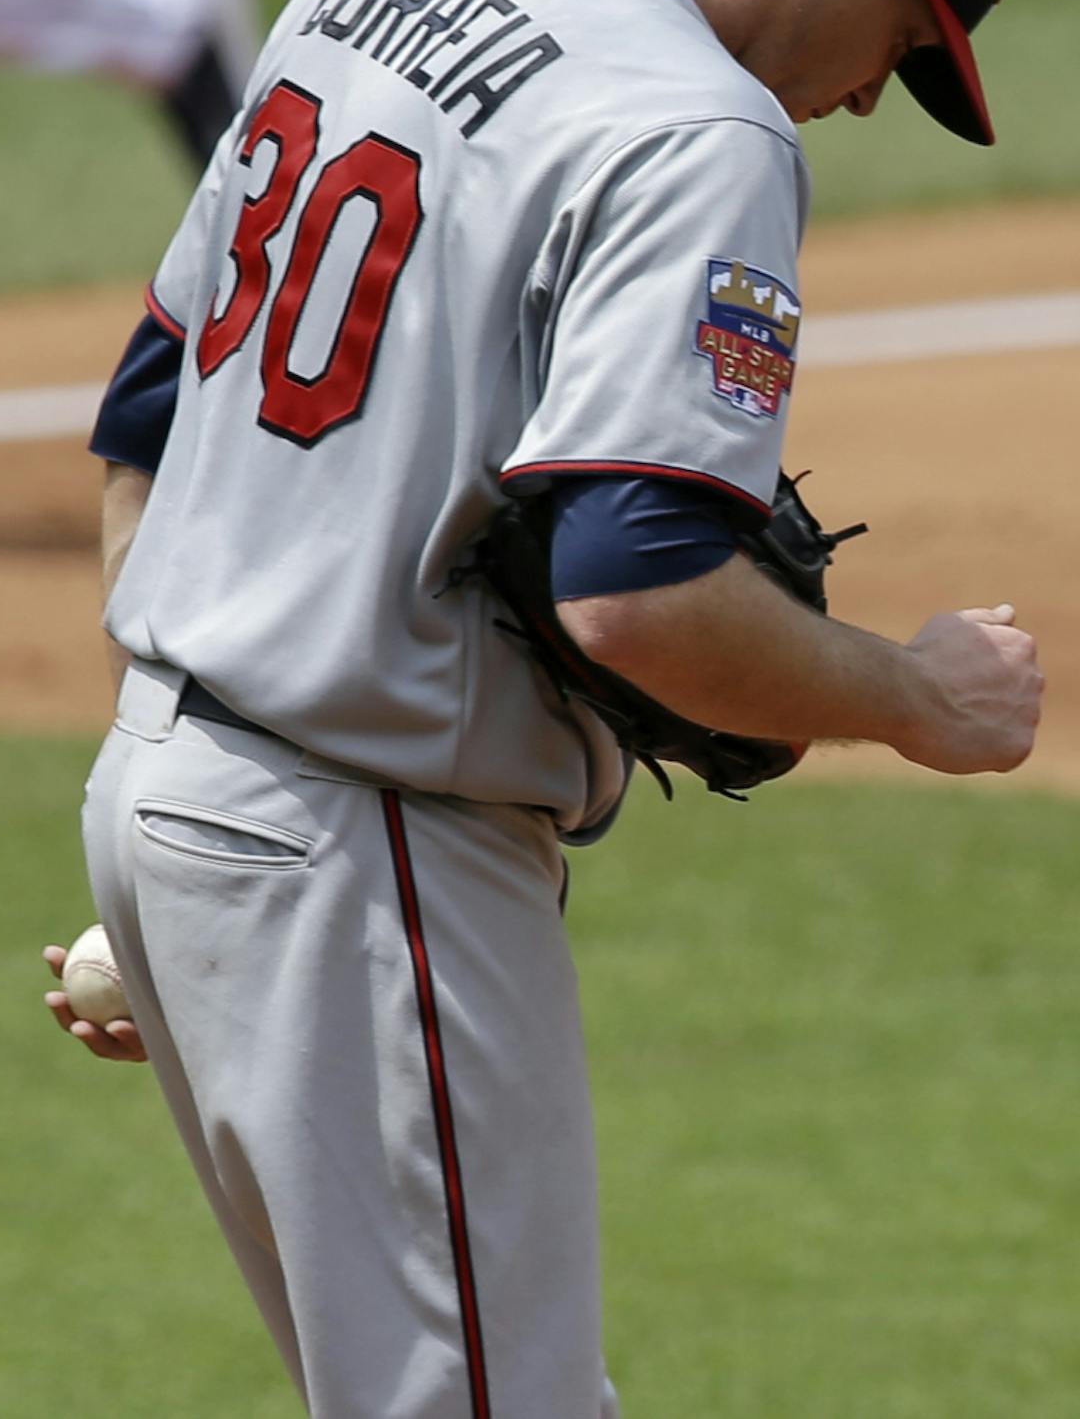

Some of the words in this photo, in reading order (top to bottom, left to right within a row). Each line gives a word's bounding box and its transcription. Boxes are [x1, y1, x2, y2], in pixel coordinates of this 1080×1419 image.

[196, 77, 424, 449] 30
[741, 323, 770, 342] MLB
[704, 332, 743, 358] ALL
[749, 346, 791, 375] STAR
[723, 358, 775, 396] GAME
